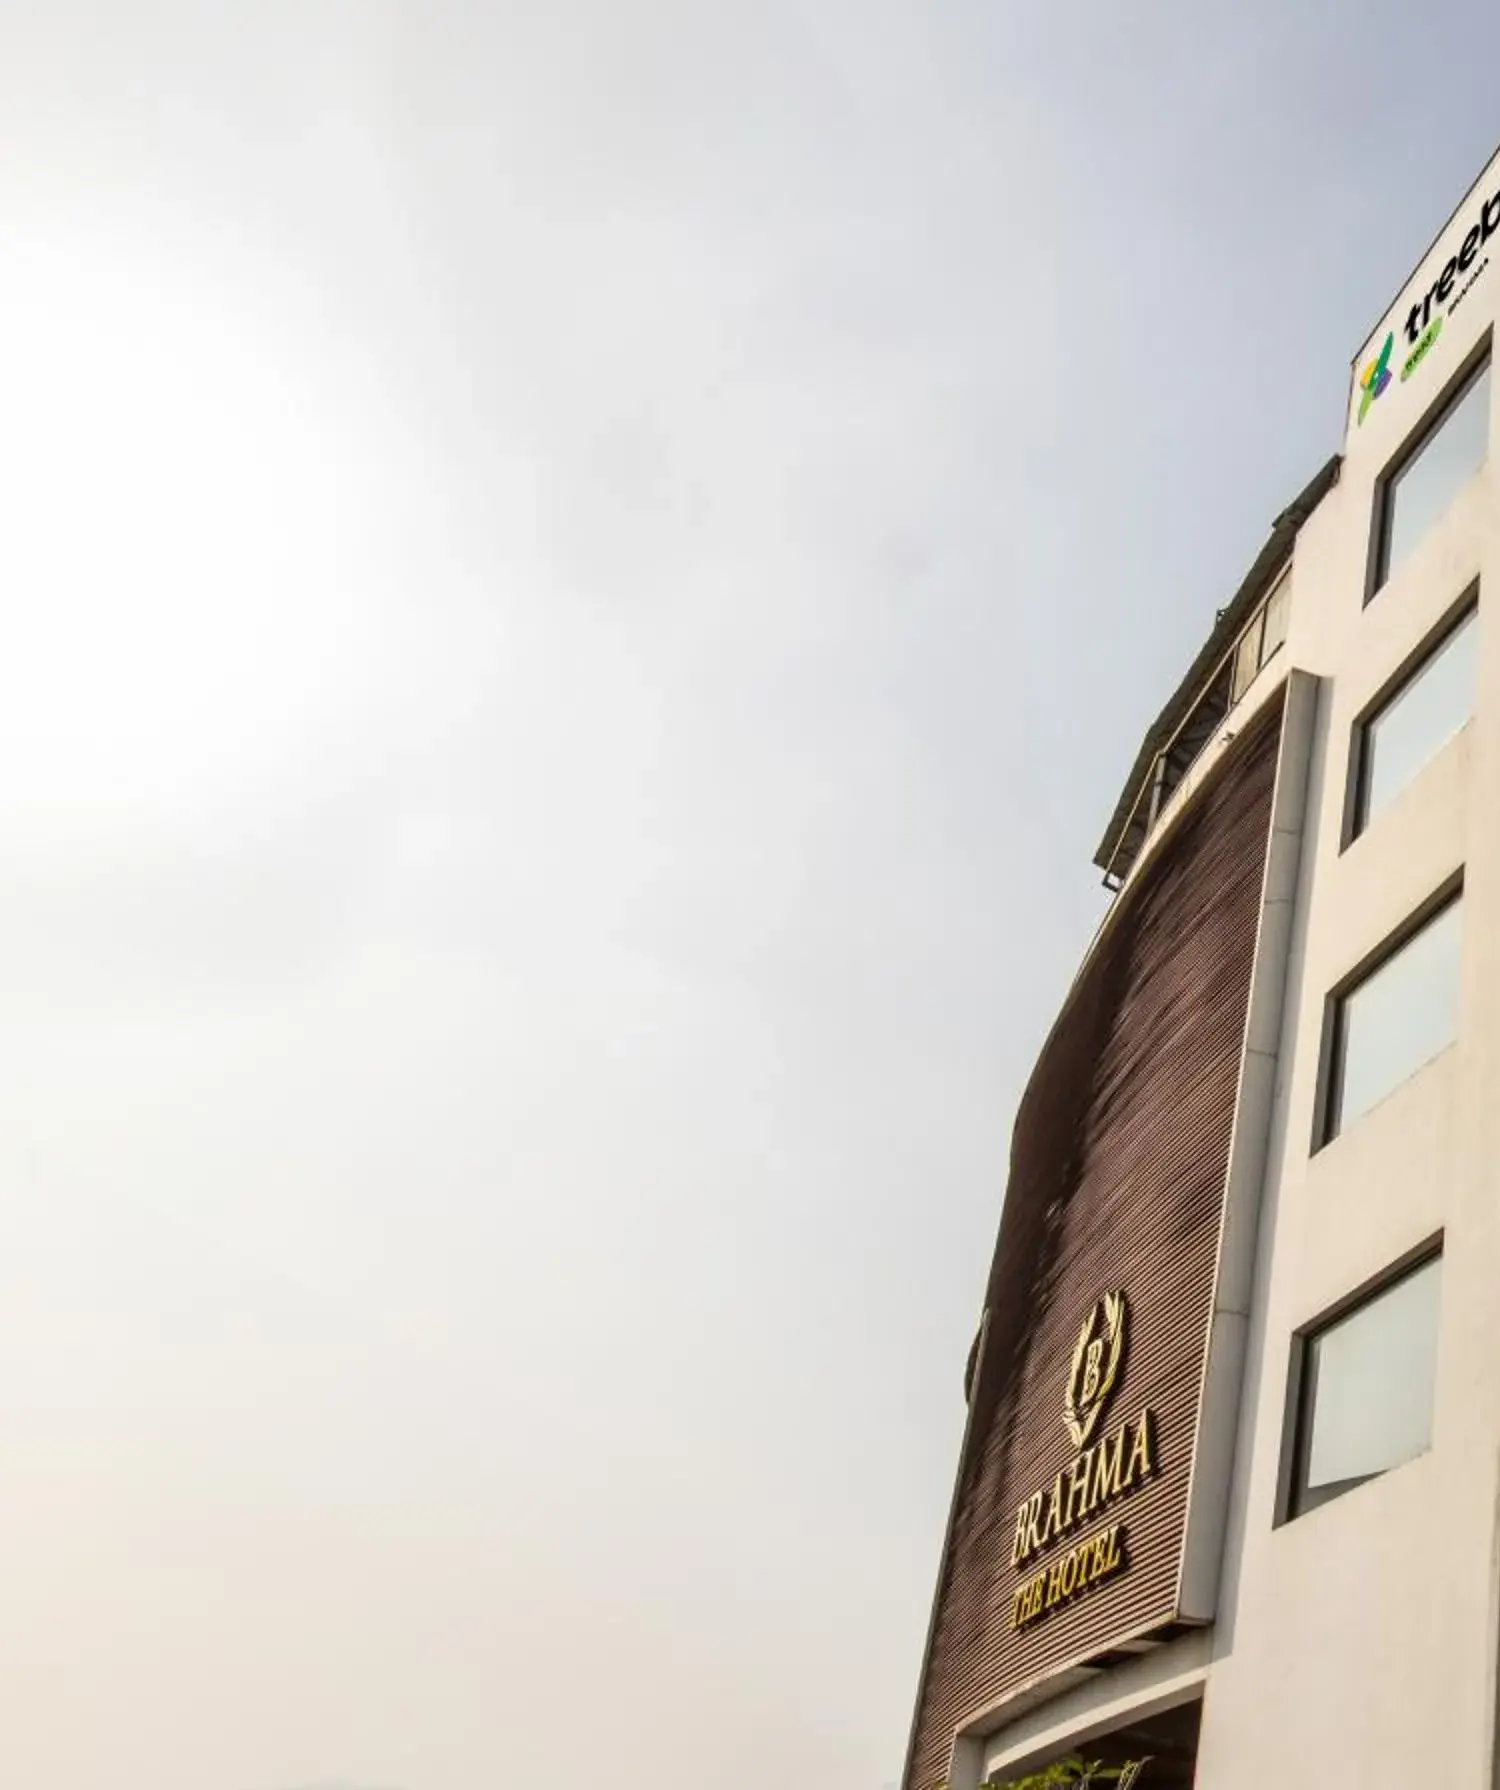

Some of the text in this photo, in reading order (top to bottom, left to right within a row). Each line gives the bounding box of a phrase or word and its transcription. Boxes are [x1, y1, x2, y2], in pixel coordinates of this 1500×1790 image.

[1011, 1408, 1152, 1567] BRAHMA
[1010, 1525, 1122, 1630] THE HOTEL
